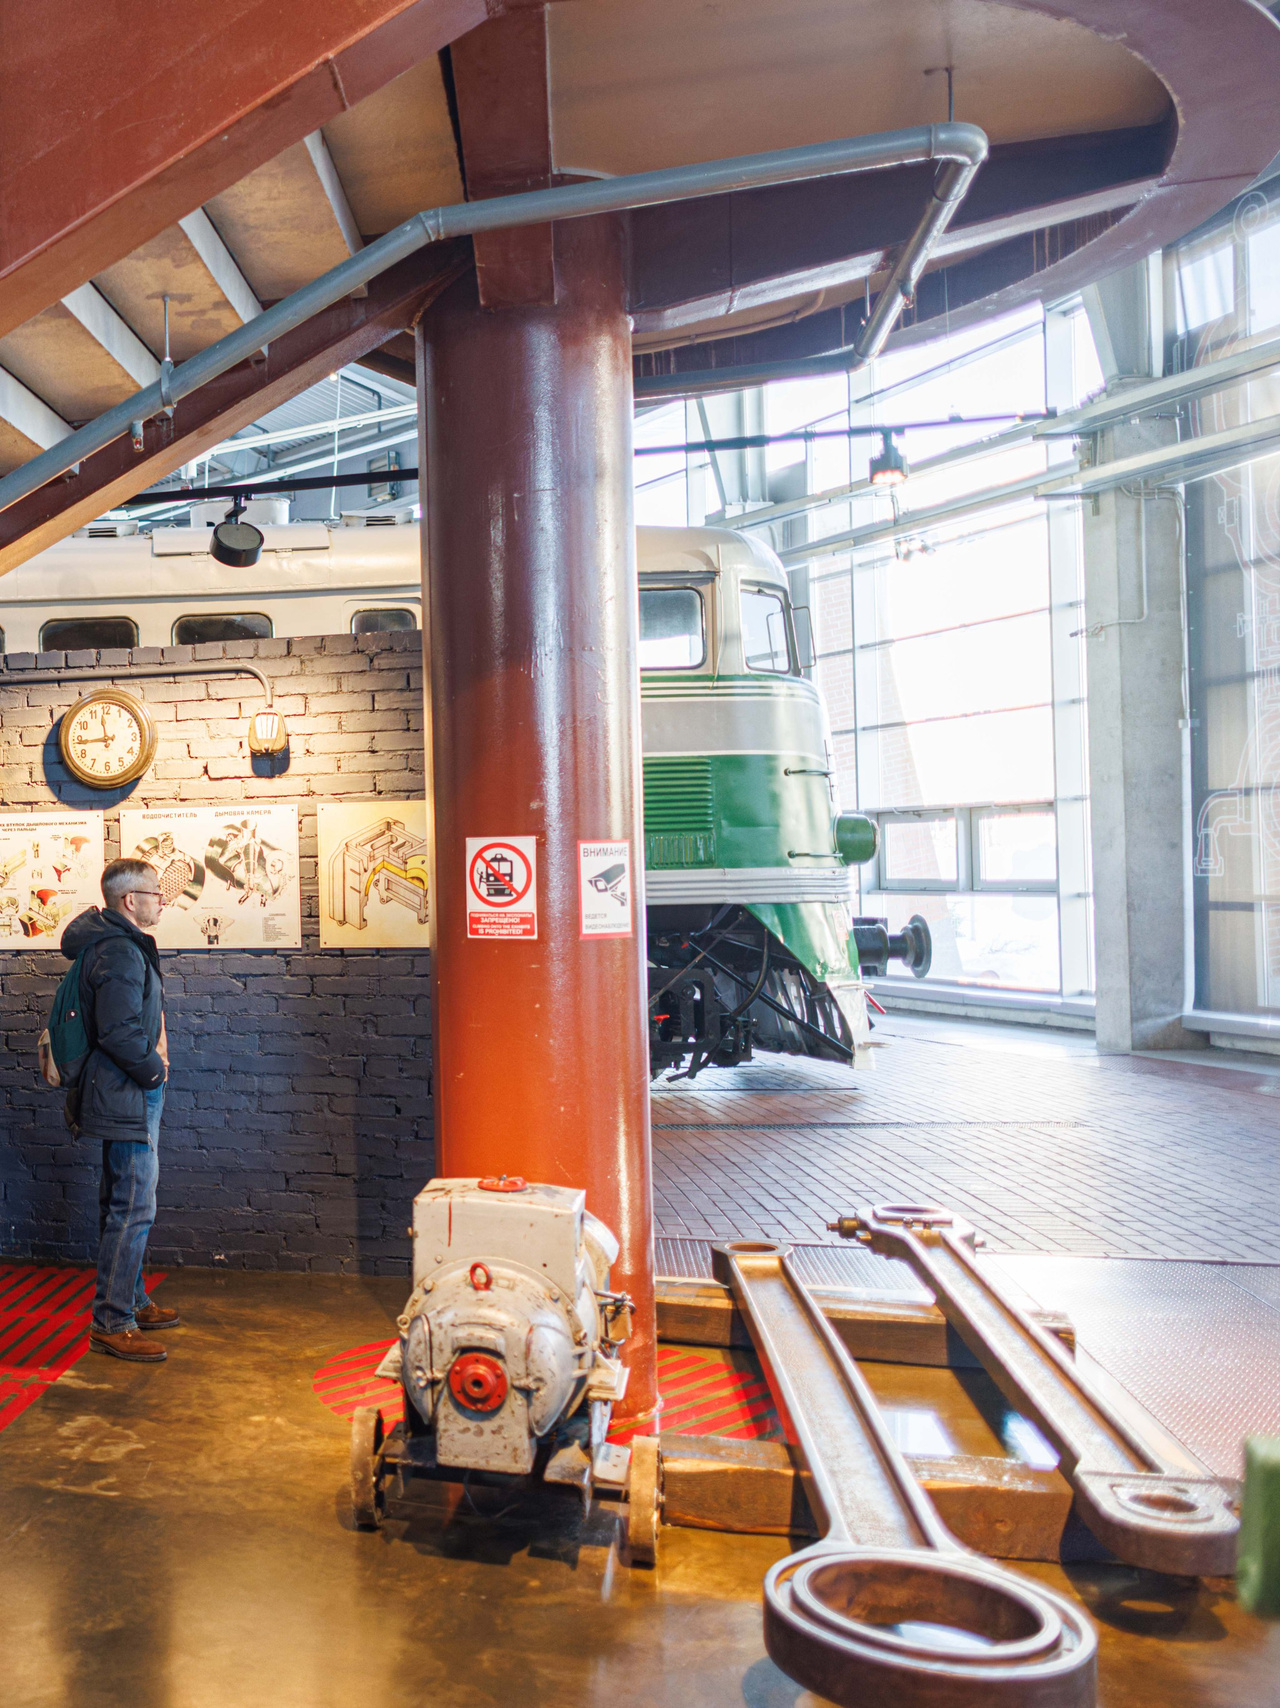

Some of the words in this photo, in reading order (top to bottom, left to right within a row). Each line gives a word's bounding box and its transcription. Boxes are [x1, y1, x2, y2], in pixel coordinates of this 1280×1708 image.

[89, 709, 97, 719] 11
[101, 705, 111, 715] 12
[117, 708, 122, 718] 1
[79, 720, 88, 730] 10
[127, 718, 133, 728] 2
[131, 732, 137, 742] 3
[80, 748, 87, 758] 8
[126, 746, 134, 756] 4
[90, 758, 96, 768] 7
[104, 761, 110, 771] 6
[118, 757, 124, 767] 5
[582, 846, 628, 858] ВНИМАНИЕ
